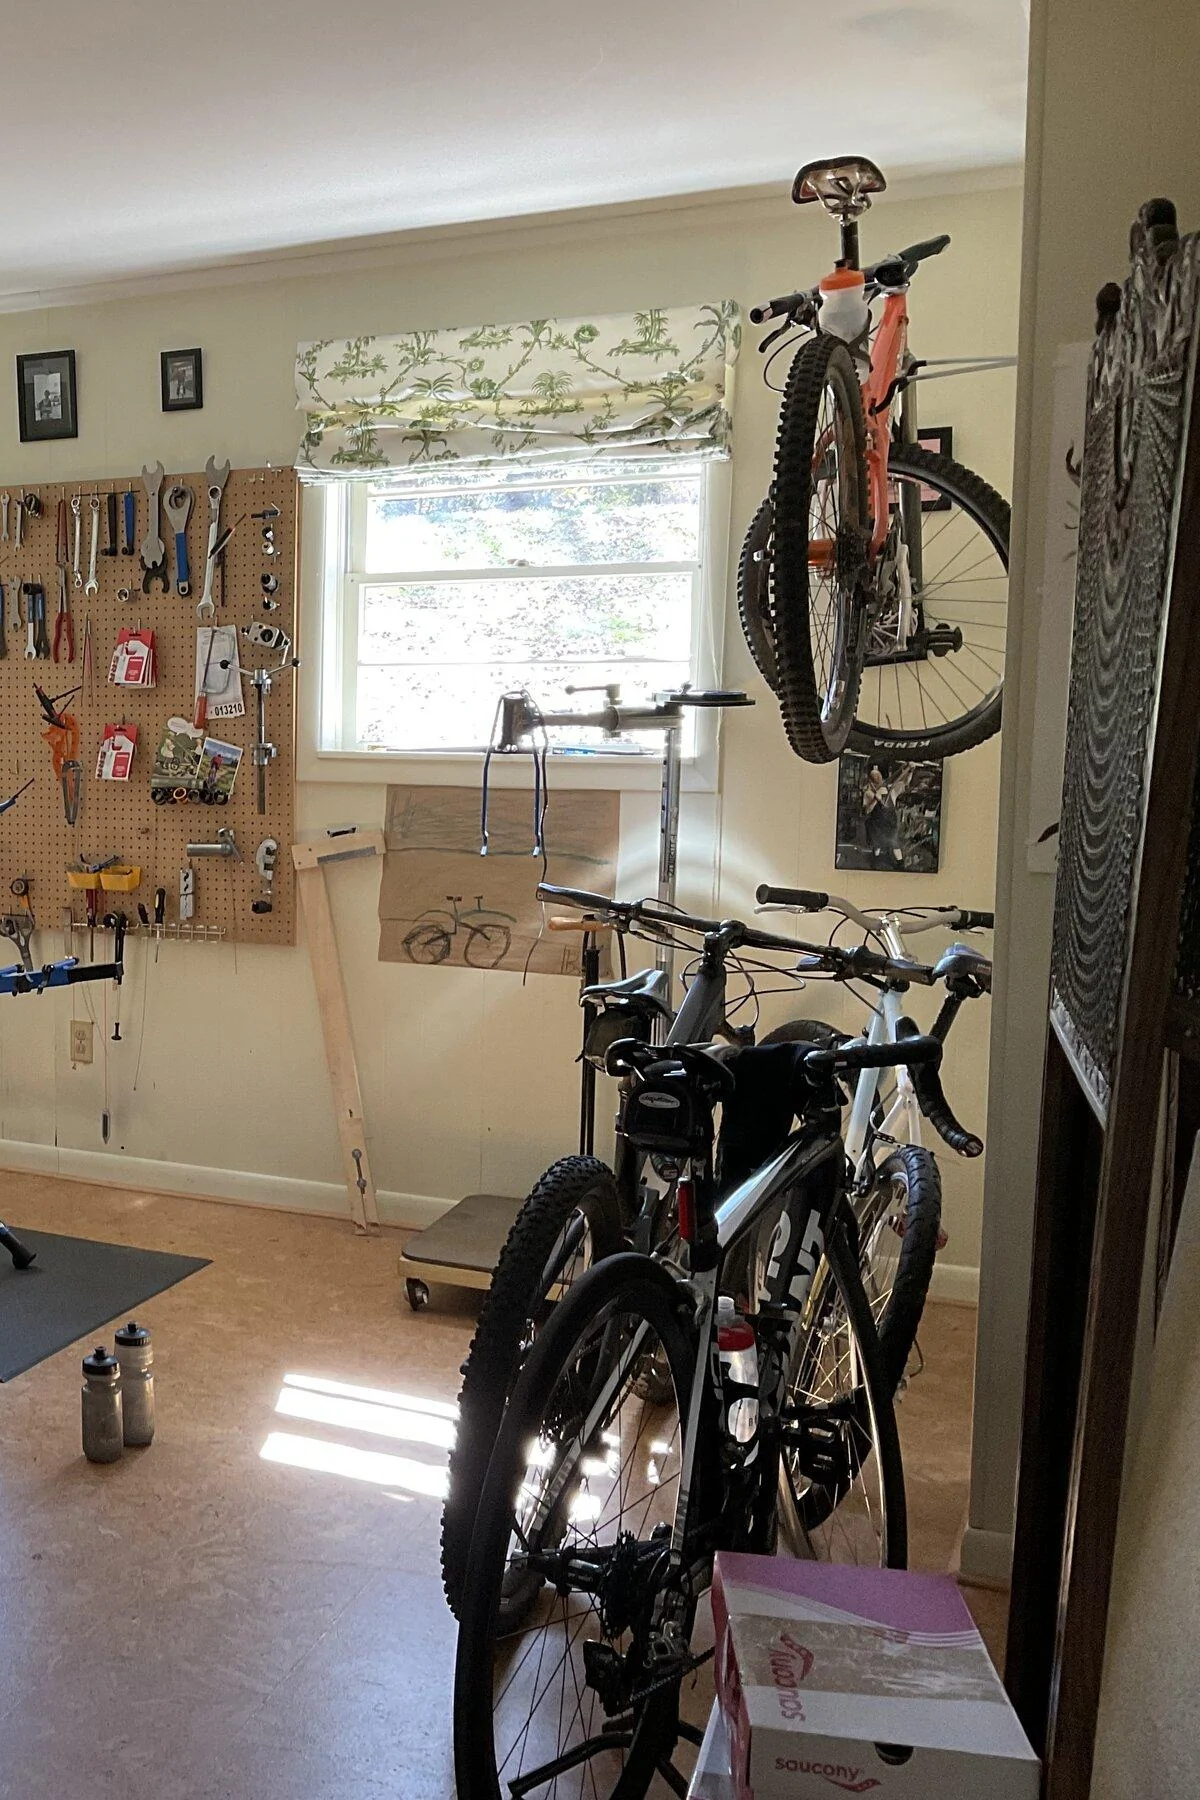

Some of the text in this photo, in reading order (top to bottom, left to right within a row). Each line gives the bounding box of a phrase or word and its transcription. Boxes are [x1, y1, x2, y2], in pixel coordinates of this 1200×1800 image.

[214, 702, 243, 717] 013210
[874, 739, 931, 749] KENDA
[768, 1648, 806, 1722] saucony
[774, 1756, 861, 1783] saucony
